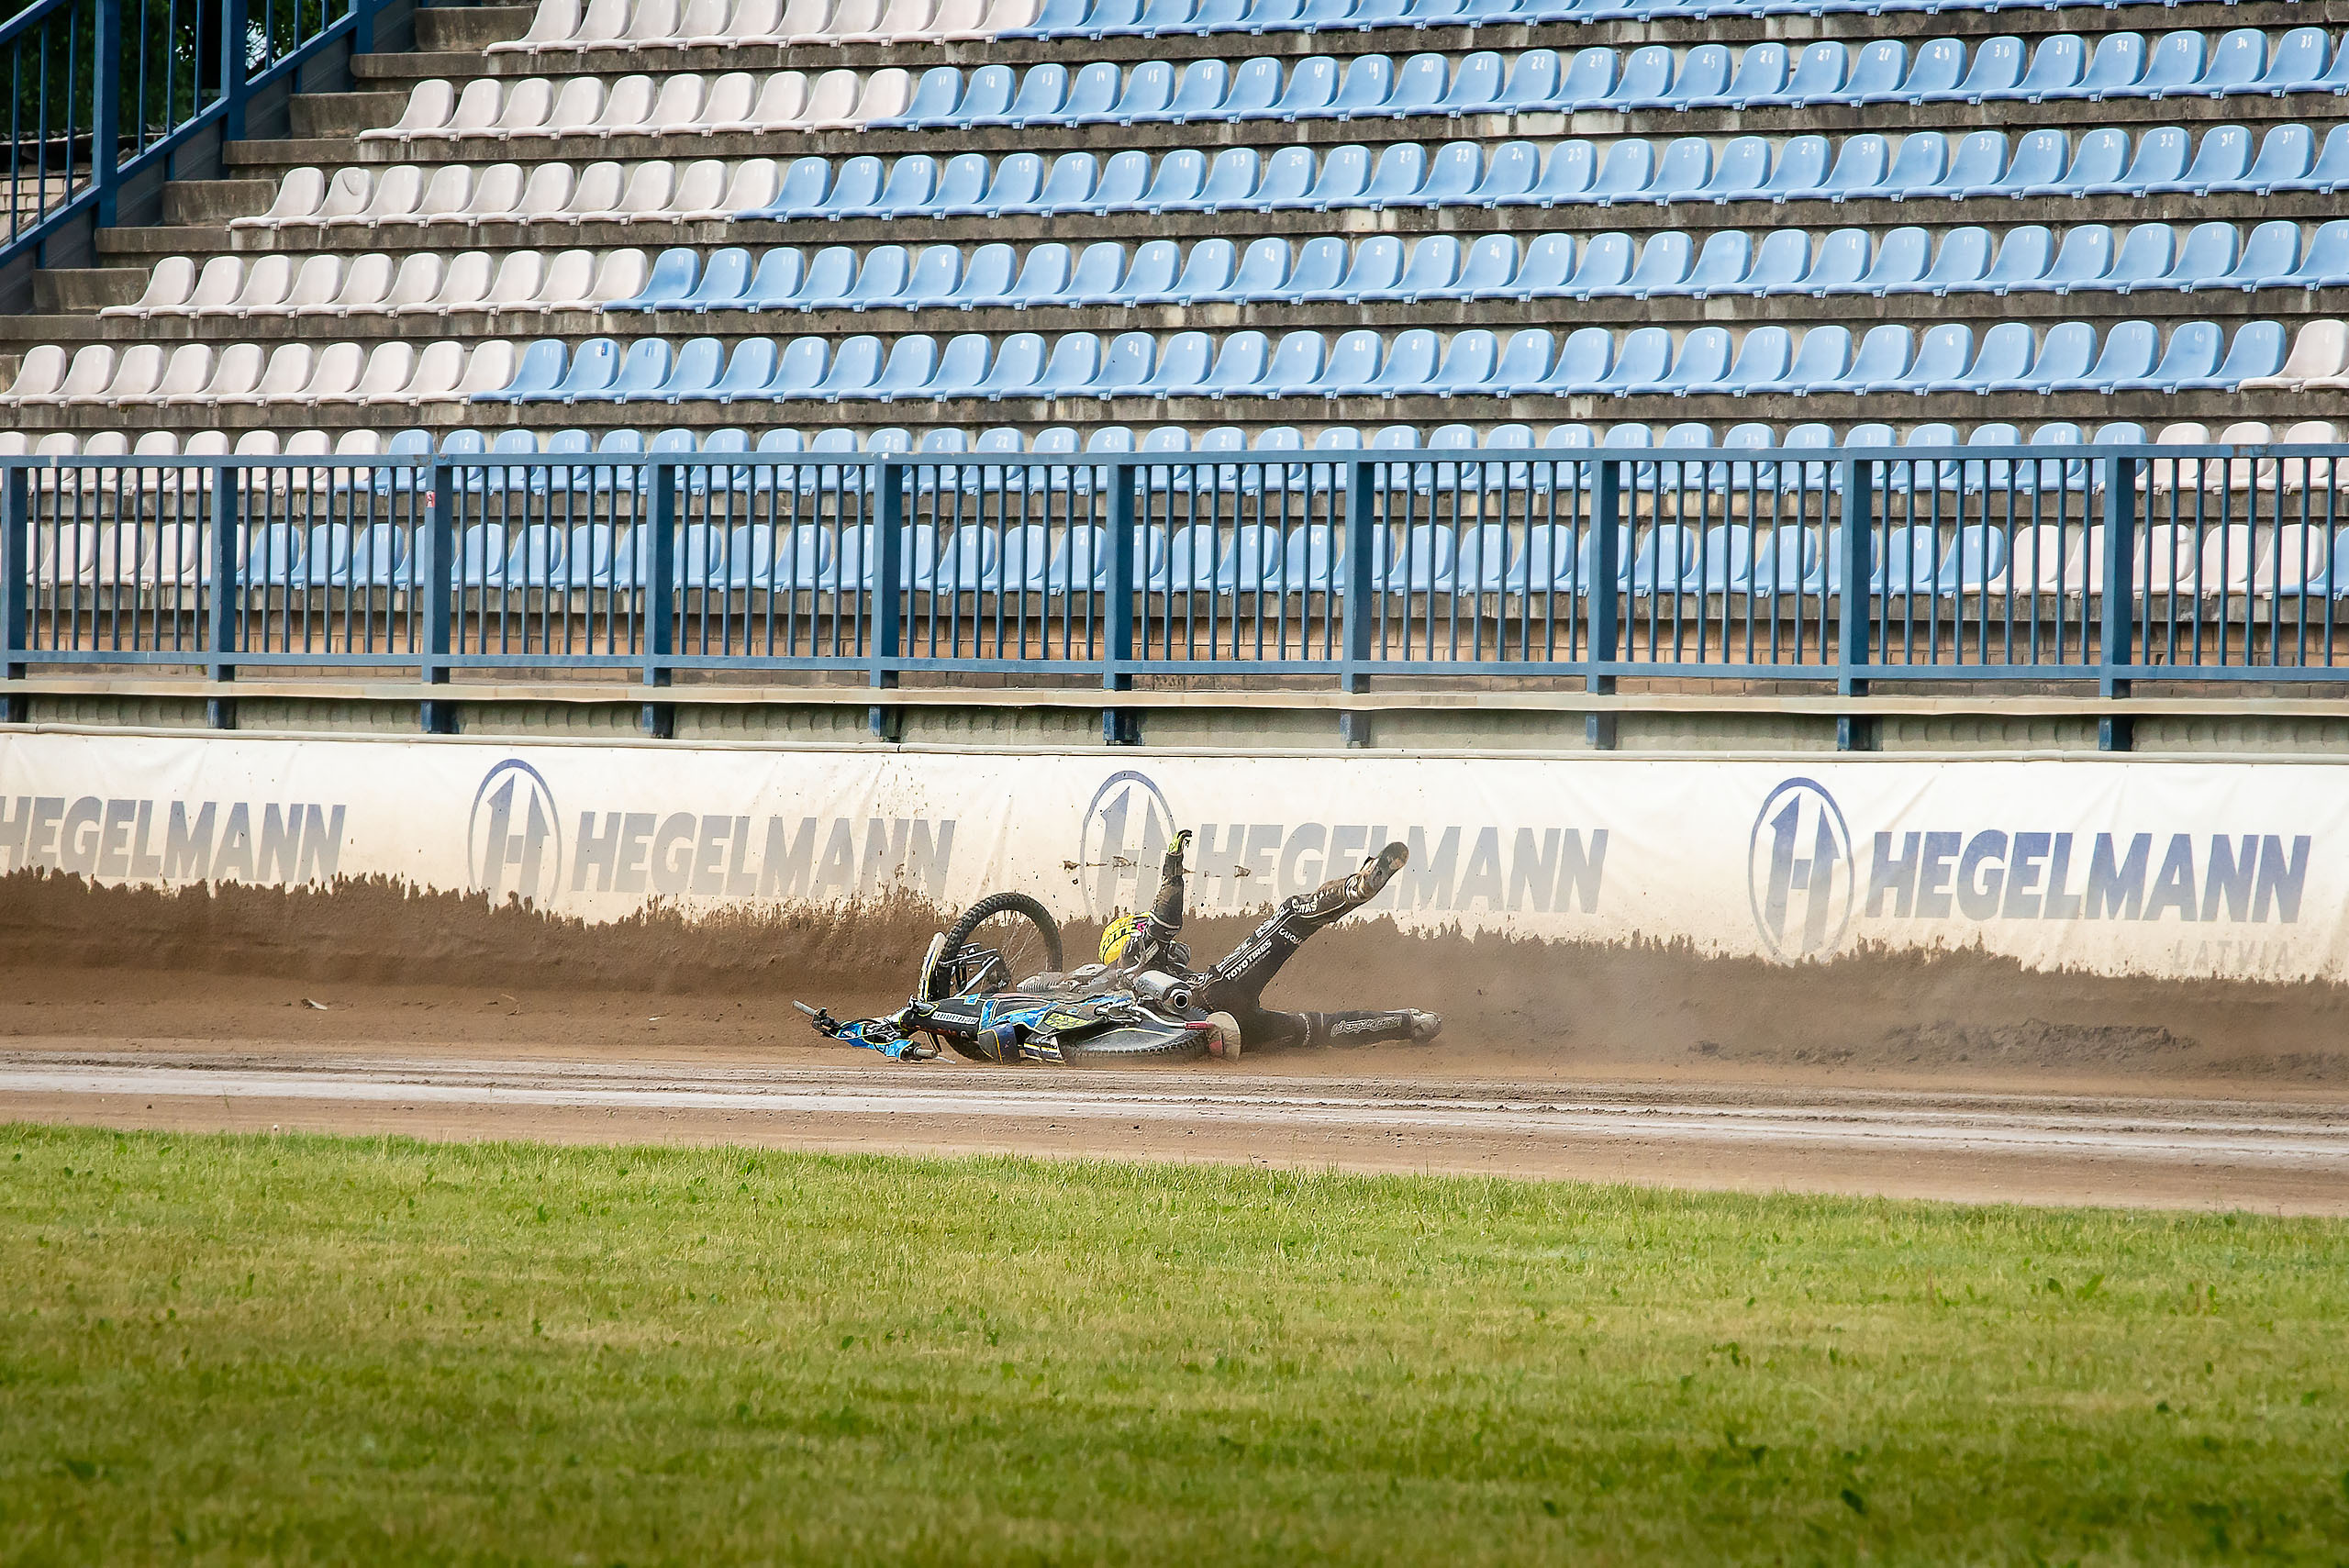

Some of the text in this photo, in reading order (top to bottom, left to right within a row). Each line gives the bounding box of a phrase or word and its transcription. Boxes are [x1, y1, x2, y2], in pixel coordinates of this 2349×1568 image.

[2056, 41, 2069, 54] 31
[2117, 39, 2128, 51] 32
[2237, 37, 2247, 49] 34
[2301, 35, 2312, 48] 35
[1818, 50, 1831, 61] 27
[1934, 46, 1949, 60] 29
[1994, 44, 2009, 58] 30
[1421, 60, 1433, 72] 20
[1475, 59, 1488, 71] 21
[1531, 56, 1545, 70] 22
[1646, 52, 1659, 66] 24
[1703, 53, 1716, 68] 25
[1148, 69, 1158, 83] 15
[1368, 62, 1379, 81] 19
[0, 795, 347, 884] HEGELMANN
[570, 811, 956, 900] HEGELMANN
[1864, 828, 2311, 923] HEGELMANN
[1225, 960, 1249, 981] TOYO
[1249, 939, 1273, 963] TIRES
